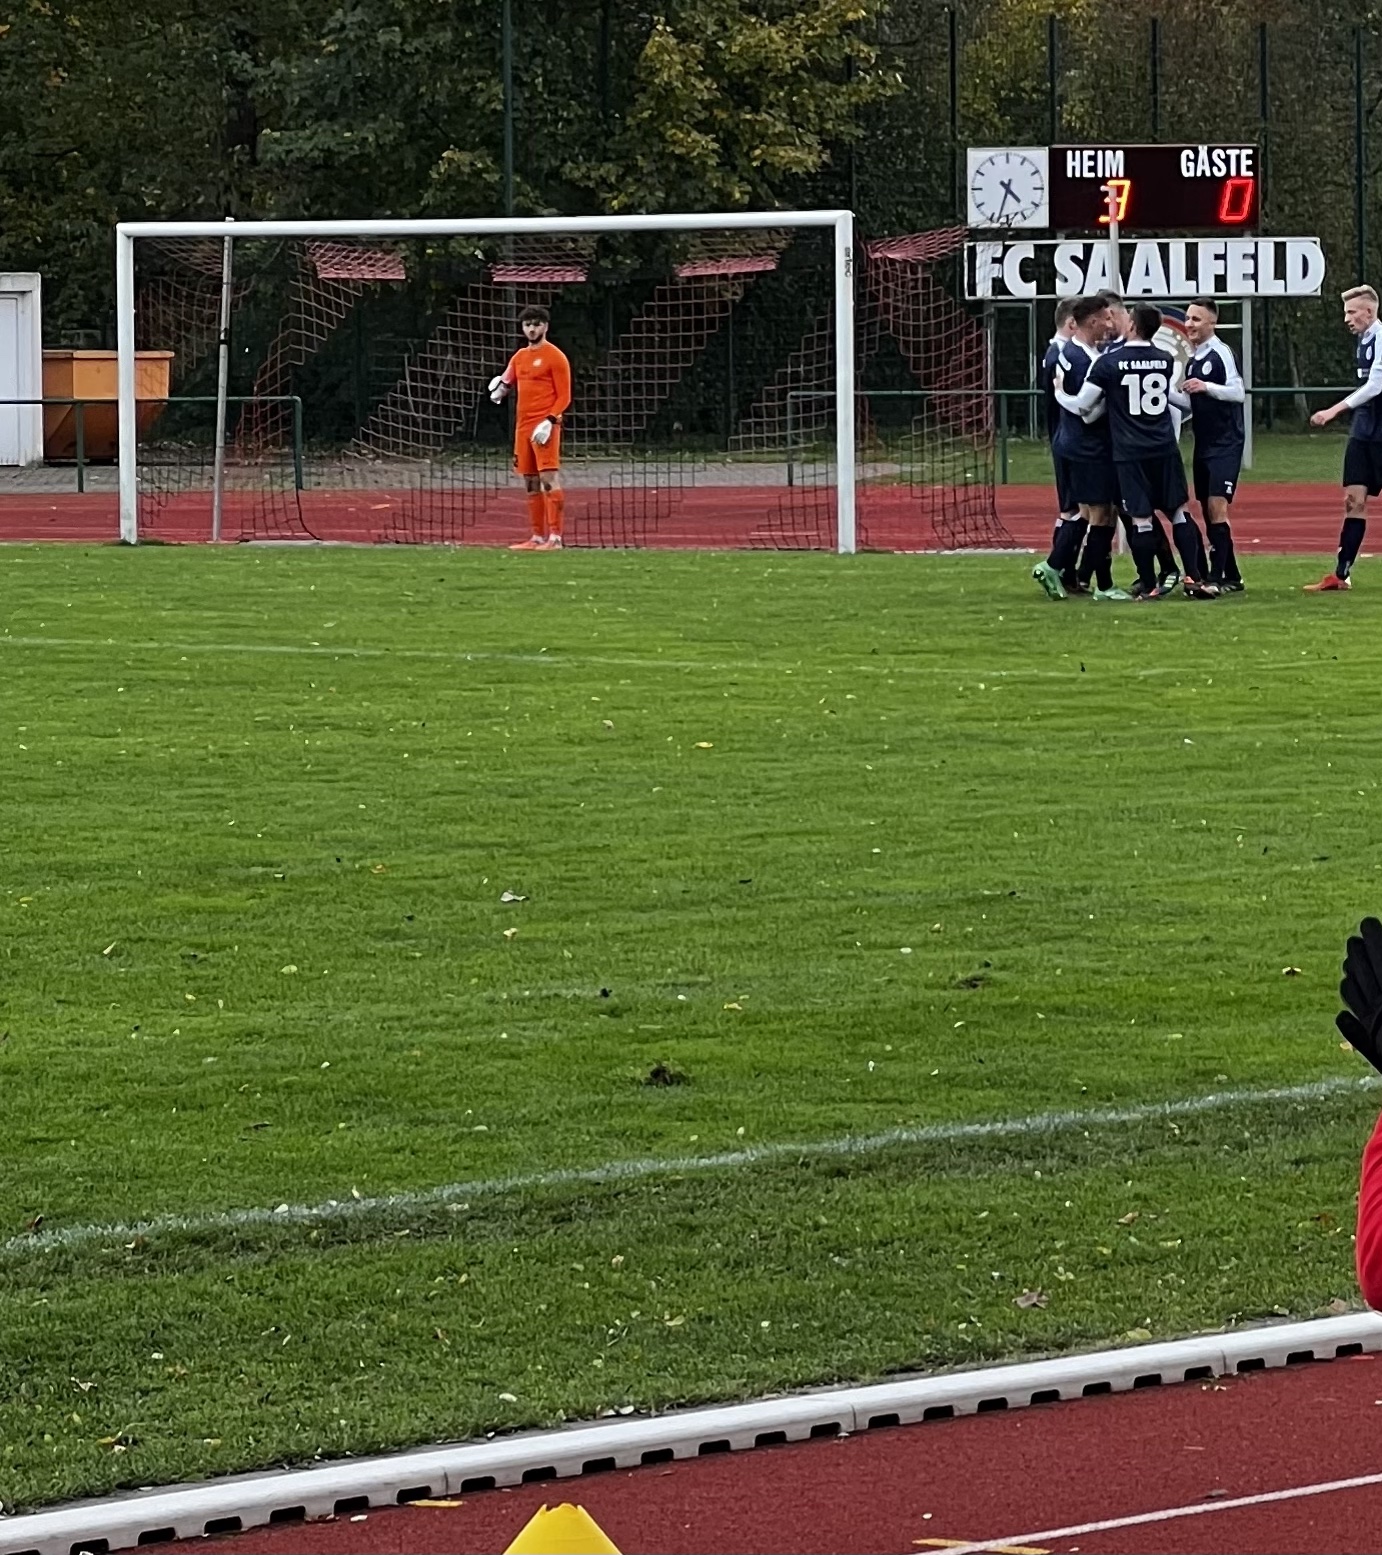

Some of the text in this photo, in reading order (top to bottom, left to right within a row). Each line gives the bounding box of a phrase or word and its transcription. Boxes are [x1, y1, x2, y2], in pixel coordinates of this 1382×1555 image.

[1066, 145, 1254, 178] HEIM GÄSTE
[1098, 178, 1255, 223] 3 0
[975, 241, 1325, 297] FC SAALFELD
[1118, 361, 1129, 371] FC
[1121, 372, 1168, 416] 18
